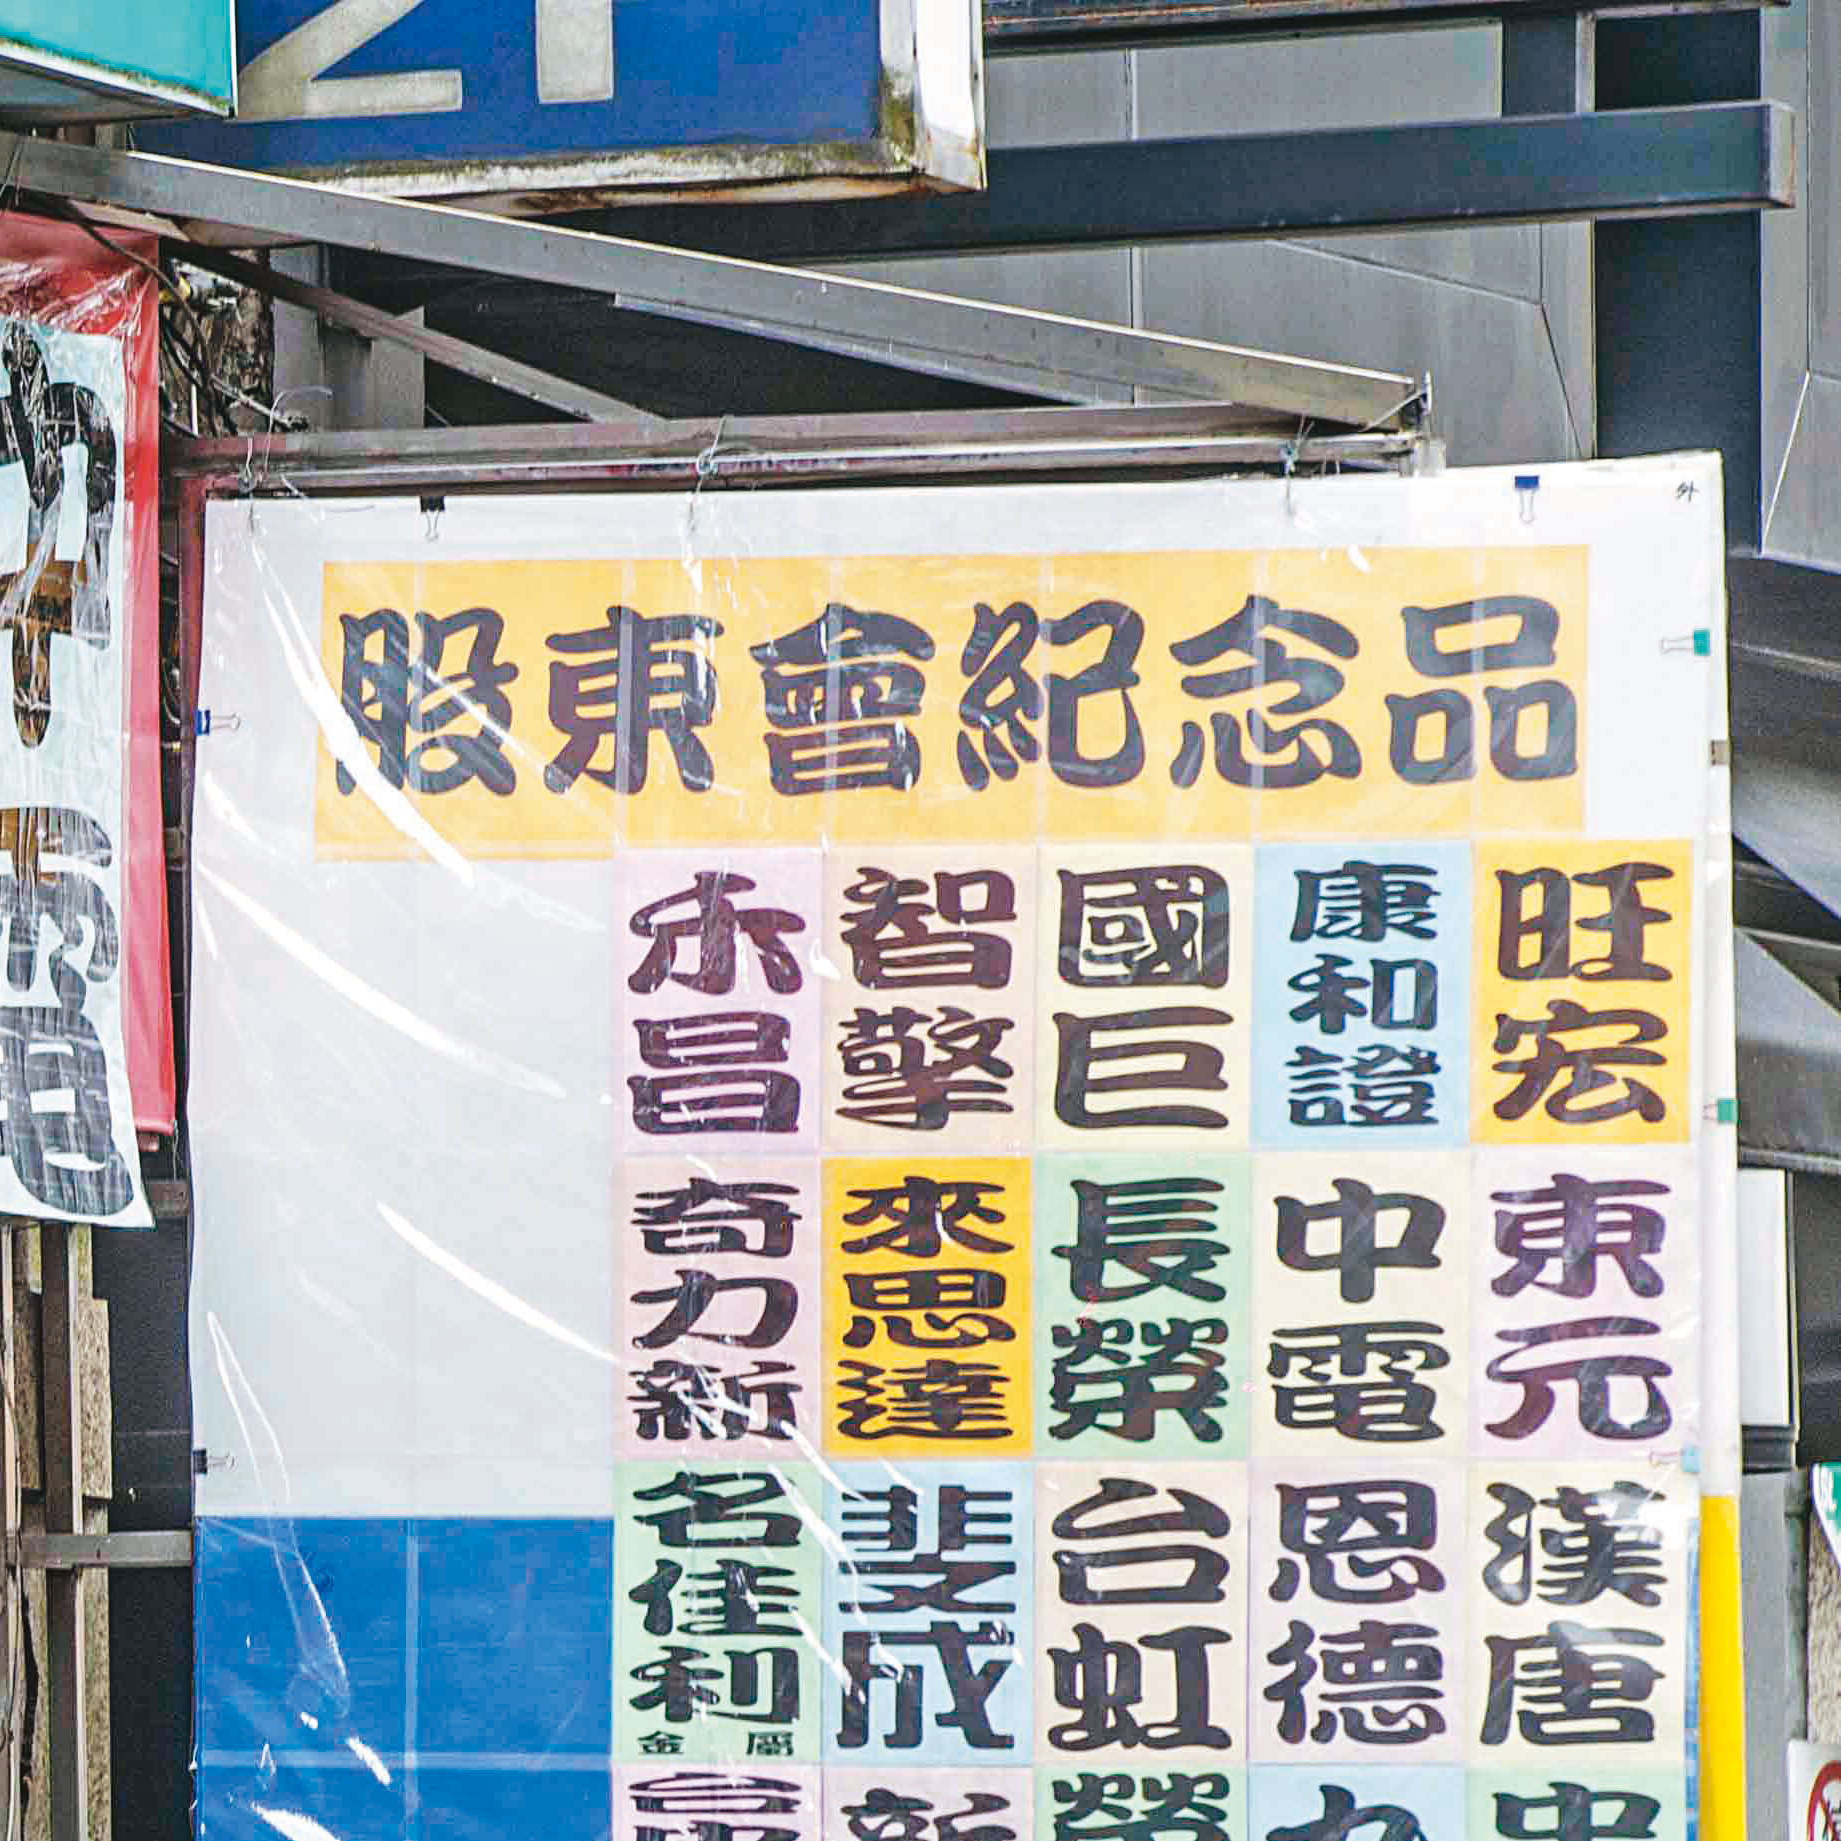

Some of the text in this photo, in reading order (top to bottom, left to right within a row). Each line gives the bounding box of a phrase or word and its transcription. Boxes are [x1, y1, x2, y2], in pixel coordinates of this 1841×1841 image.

[336, 597, 1580, 795] 股東會紀念品
[627, 873, 805, 1134] 禾昌
[837, 868, 1016, 1129] 智擎
[1053, 866, 1233, 1128] 國巨
[1286, 861, 1440, 1126] 康和證
[1493, 863, 1672, 1122] 旺宏
[628, 1178, 801, 1440] 奇力新
[838, 1176, 1015, 1440] 來思達
[1049, 1178, 1230, 1442] 長榮
[1268, 1179, 1449, 1441] 中電
[1486, 1175, 1671, 1439] 東元
[629, 1472, 802, 1728] 名佳利
[837, 1486, 1015, 1748] 斐成
[1047, 1479, 1231, 1751] 台虹
[1264, 1481, 1445, 1744] 恩德
[1481, 1483, 1665, 1745] 漢唐
